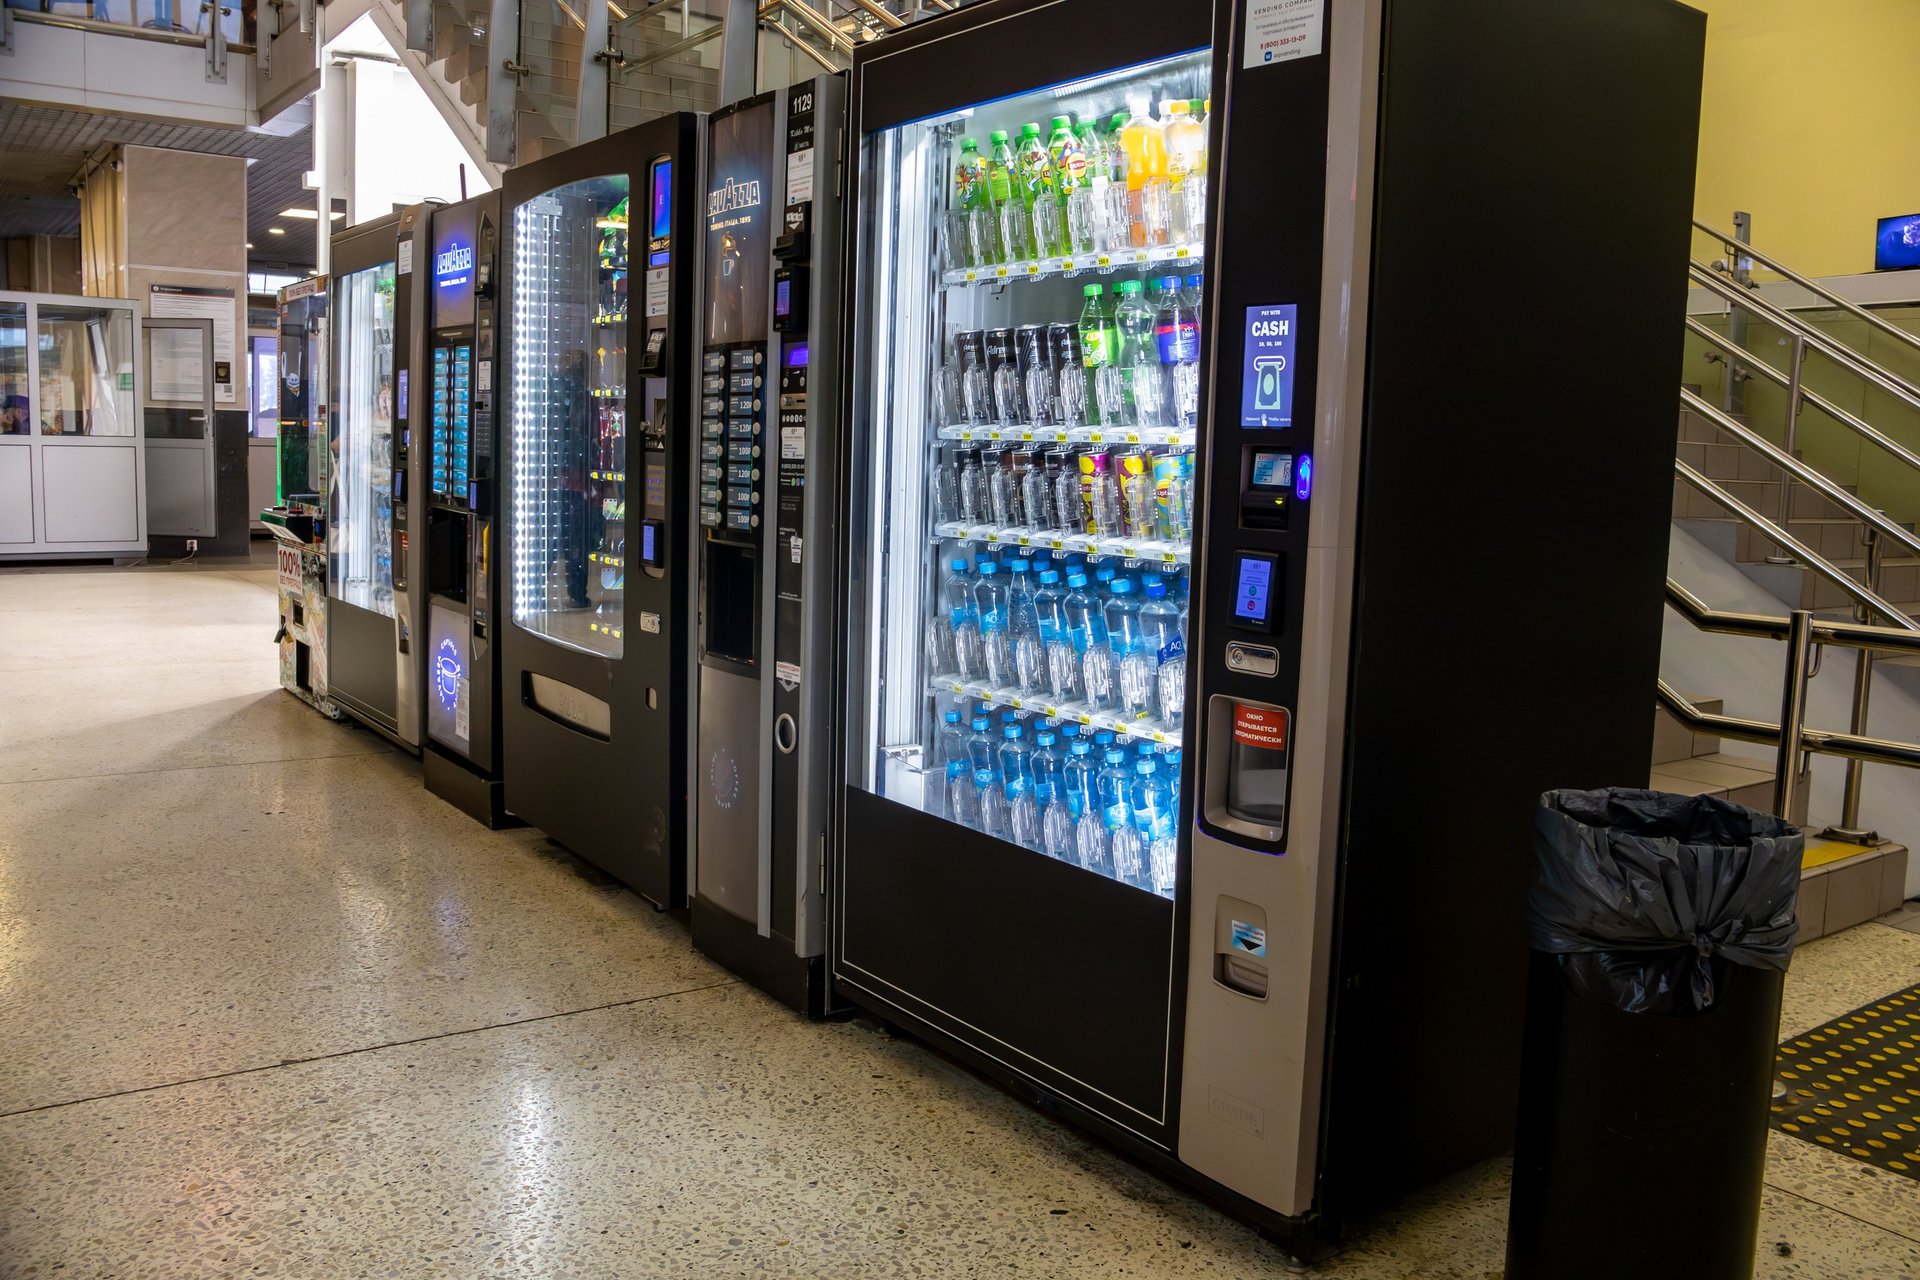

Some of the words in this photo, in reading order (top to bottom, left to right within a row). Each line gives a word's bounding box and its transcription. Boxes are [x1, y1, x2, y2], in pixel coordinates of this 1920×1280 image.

[1254, 4, 1283, 15] VENDING
[1285, 0, 1316, 8] COMPAN
[1264, 40, 1279, 50] (800)
[1280, 34, 1306, 46] 333-13-09
[793, 93, 812, 114] 1129
[707, 177, 760, 217] LAVAZZA
[1252, 320, 1289, 336] CASH
[279, 550, 300, 577] 100%
[1246, 713, 1263, 721] ОКНО
[1238, 720, 1277, 733] ОТКРЫВАЕТСЯ
